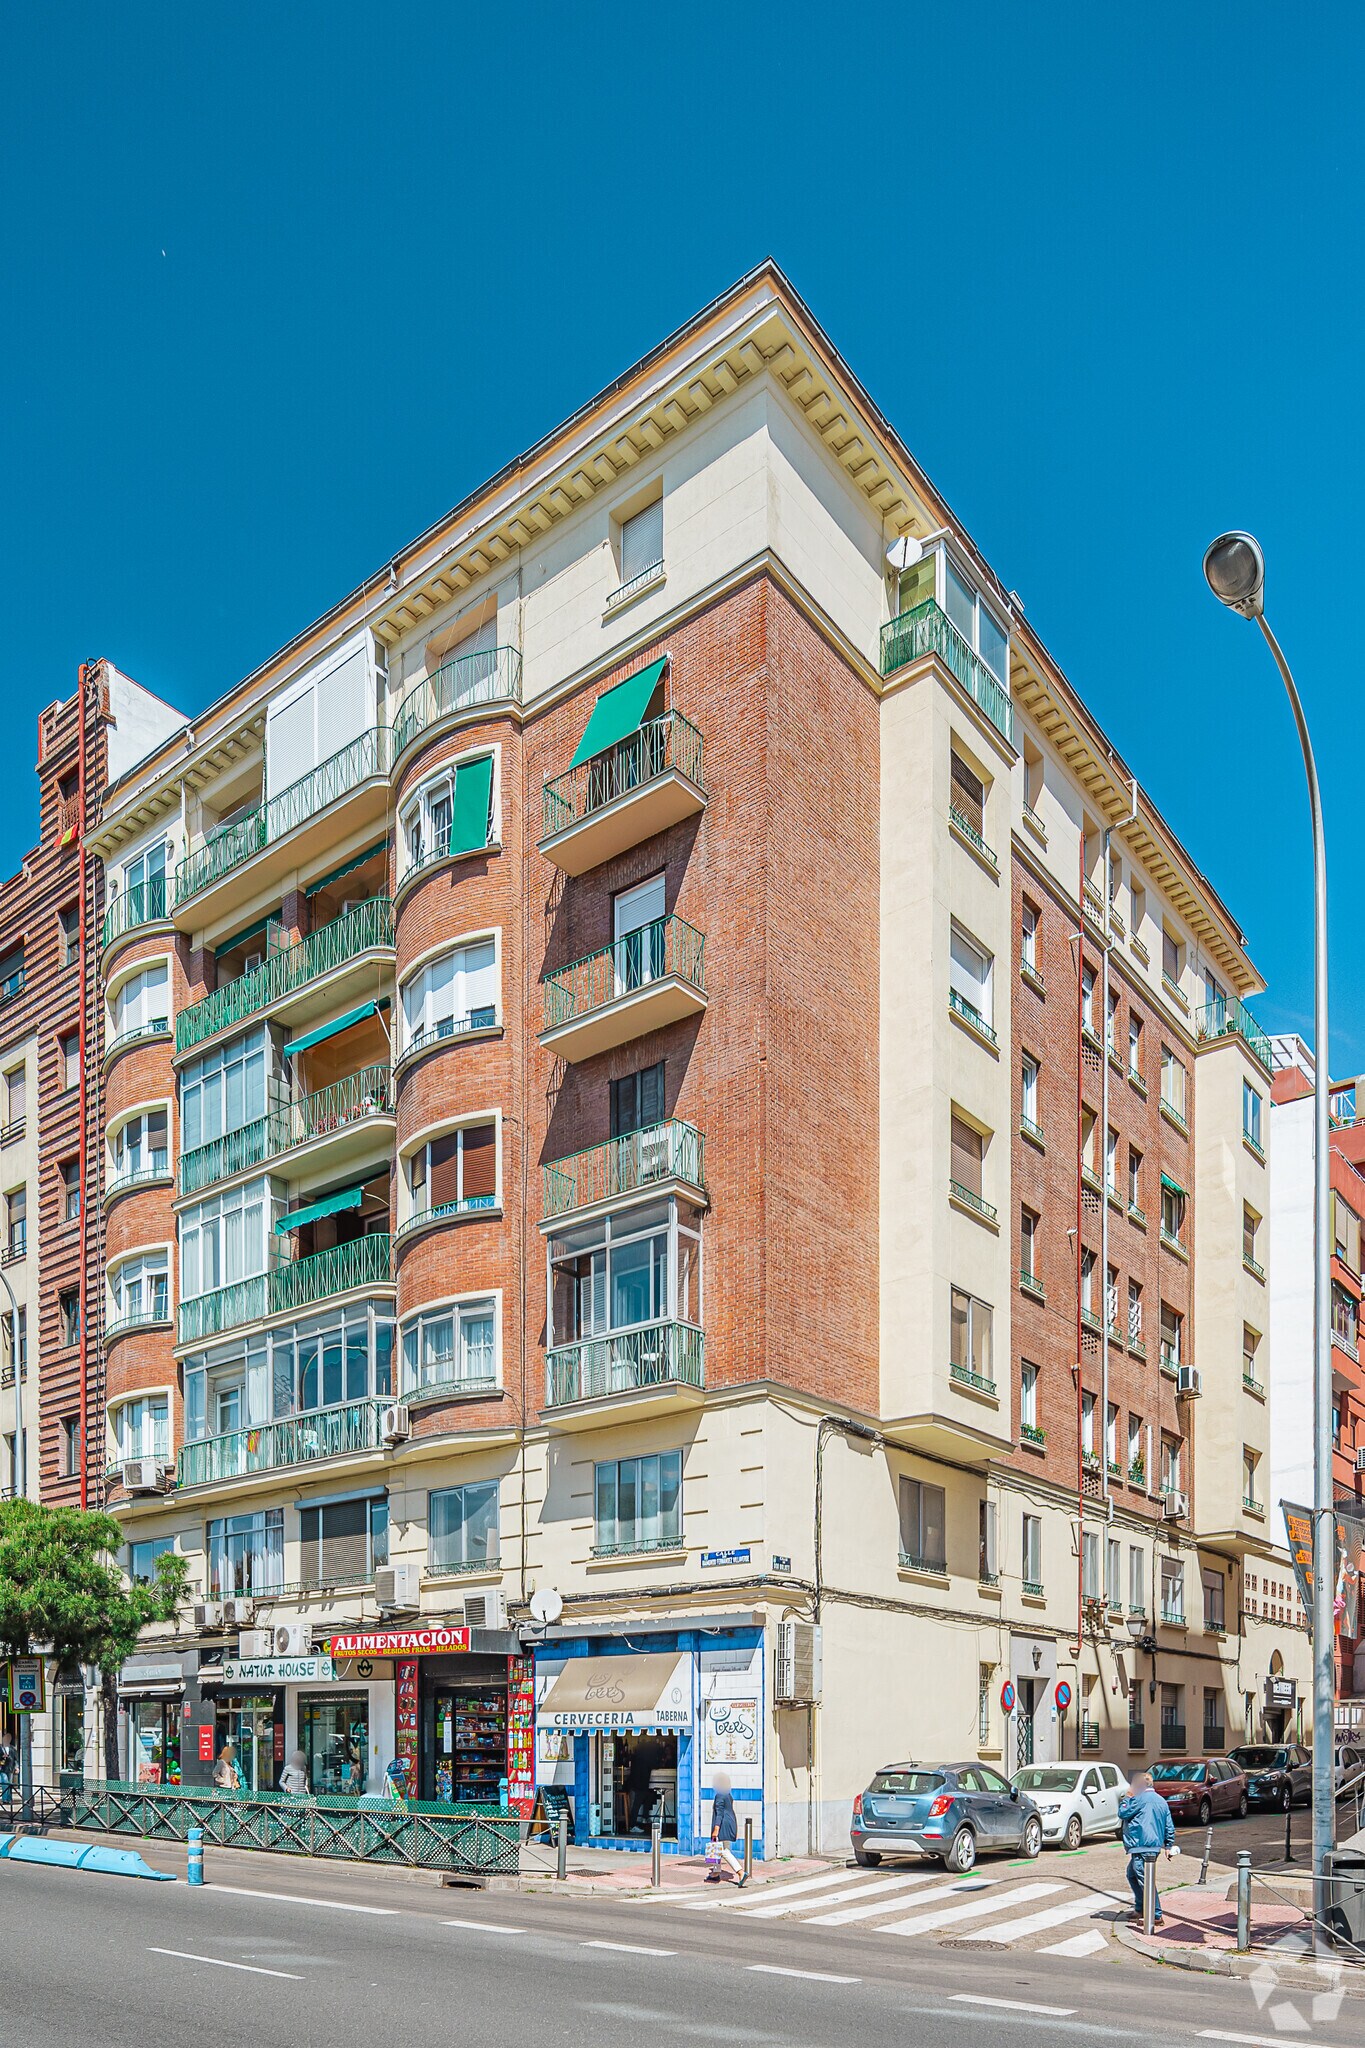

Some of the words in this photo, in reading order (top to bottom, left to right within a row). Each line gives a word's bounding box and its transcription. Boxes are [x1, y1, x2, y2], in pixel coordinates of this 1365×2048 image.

[335, 1629, 463, 1650] ALIMENTACIÓN
[357, 1648, 377, 1656] SECOS
[383, 1647, 410, 1655] BEBIDAS
[436, 1644, 467, 1652] HELADOS
[239, 1664, 275, 1678] NATUR
[278, 1662, 315, 1677] HOUSE
[554, 1712, 634, 1725] CERVECERIA
[656, 1710, 688, 1722] TABERNA
[713, 1706, 727, 1716] LAS
